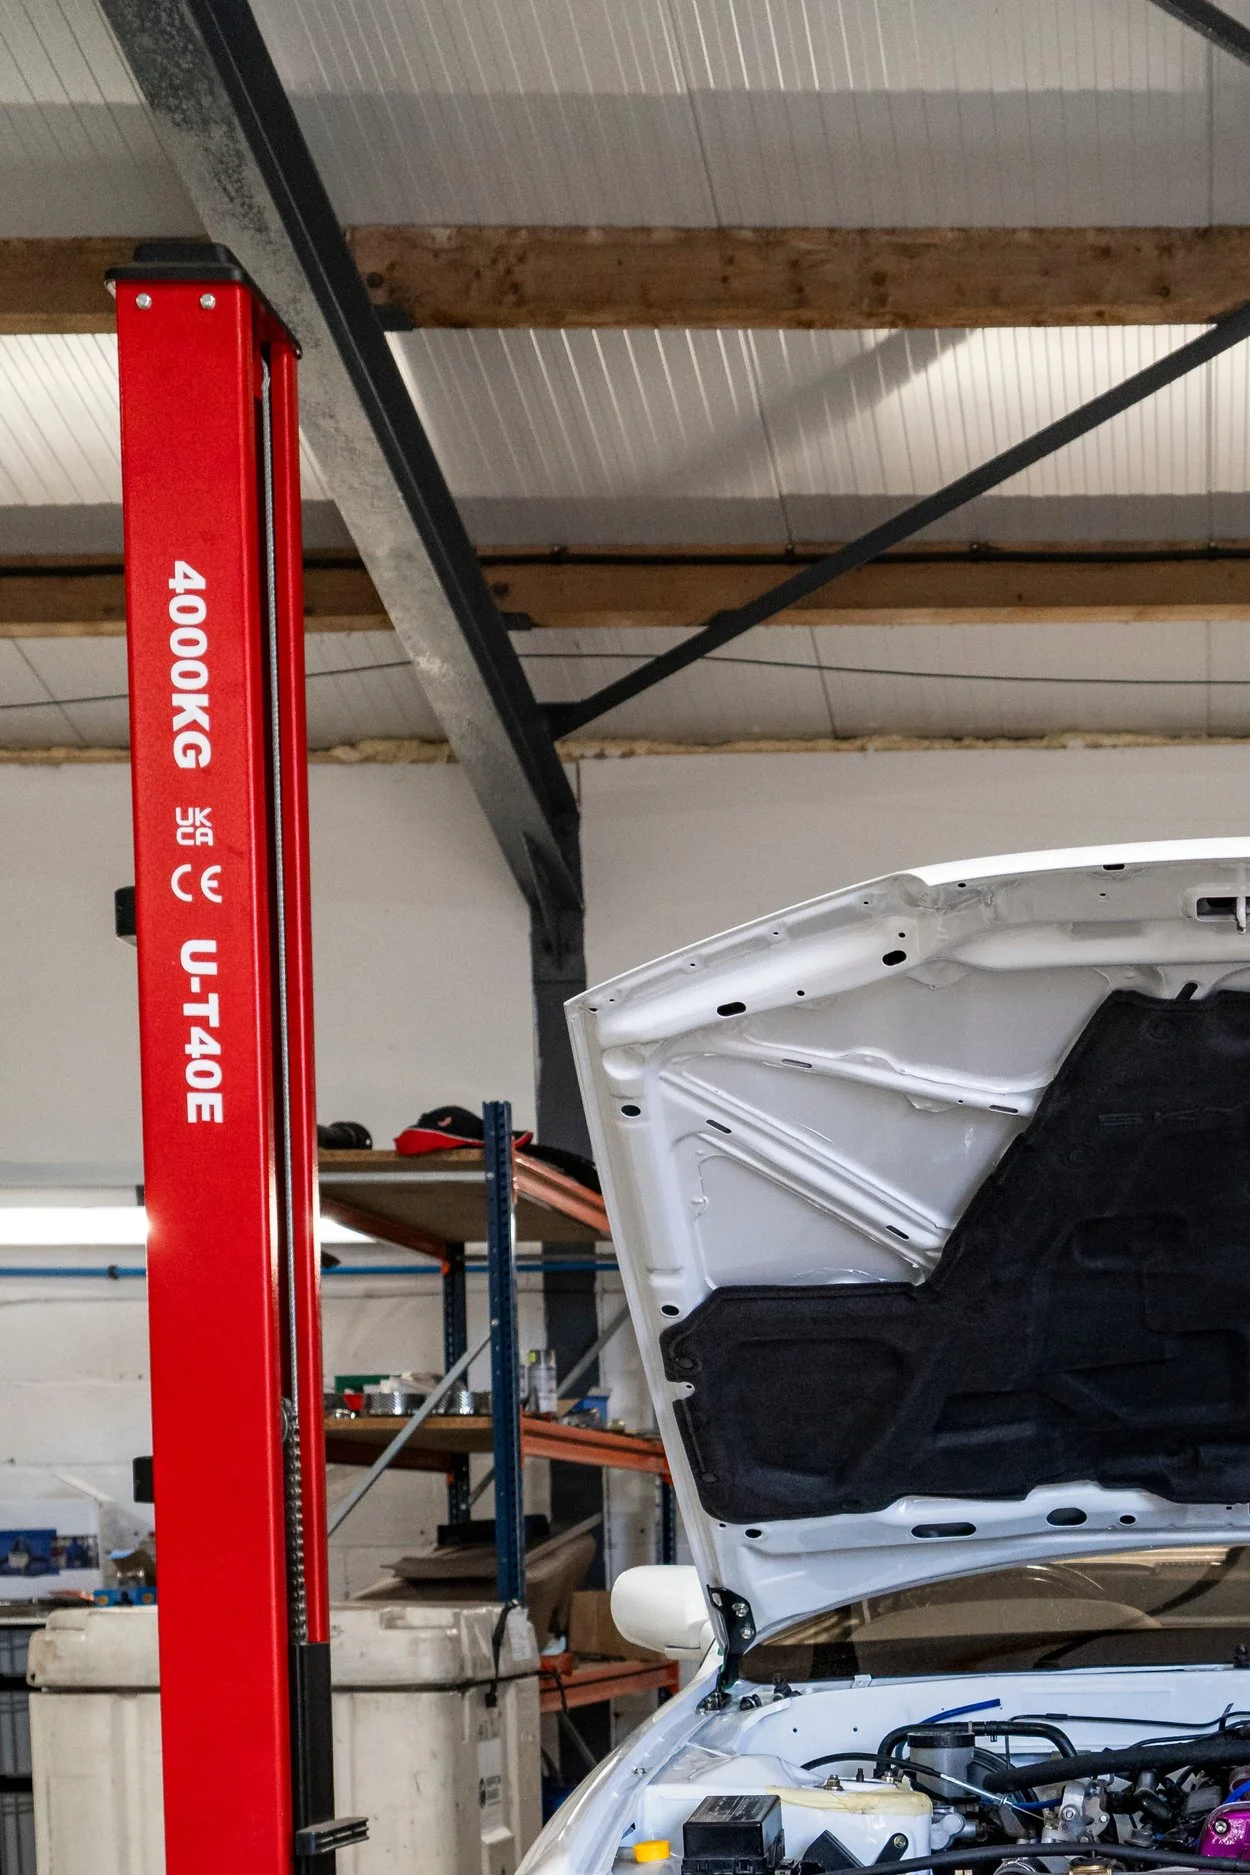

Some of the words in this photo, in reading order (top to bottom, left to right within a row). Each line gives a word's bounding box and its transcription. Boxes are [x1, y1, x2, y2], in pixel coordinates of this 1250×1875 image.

[169, 560, 212, 769] 4000KG
[176, 807, 212, 827] UK
[176, 827, 214, 846] CA
[171, 864, 222, 903] CE
[180, 939, 223, 1124] U-T40E
